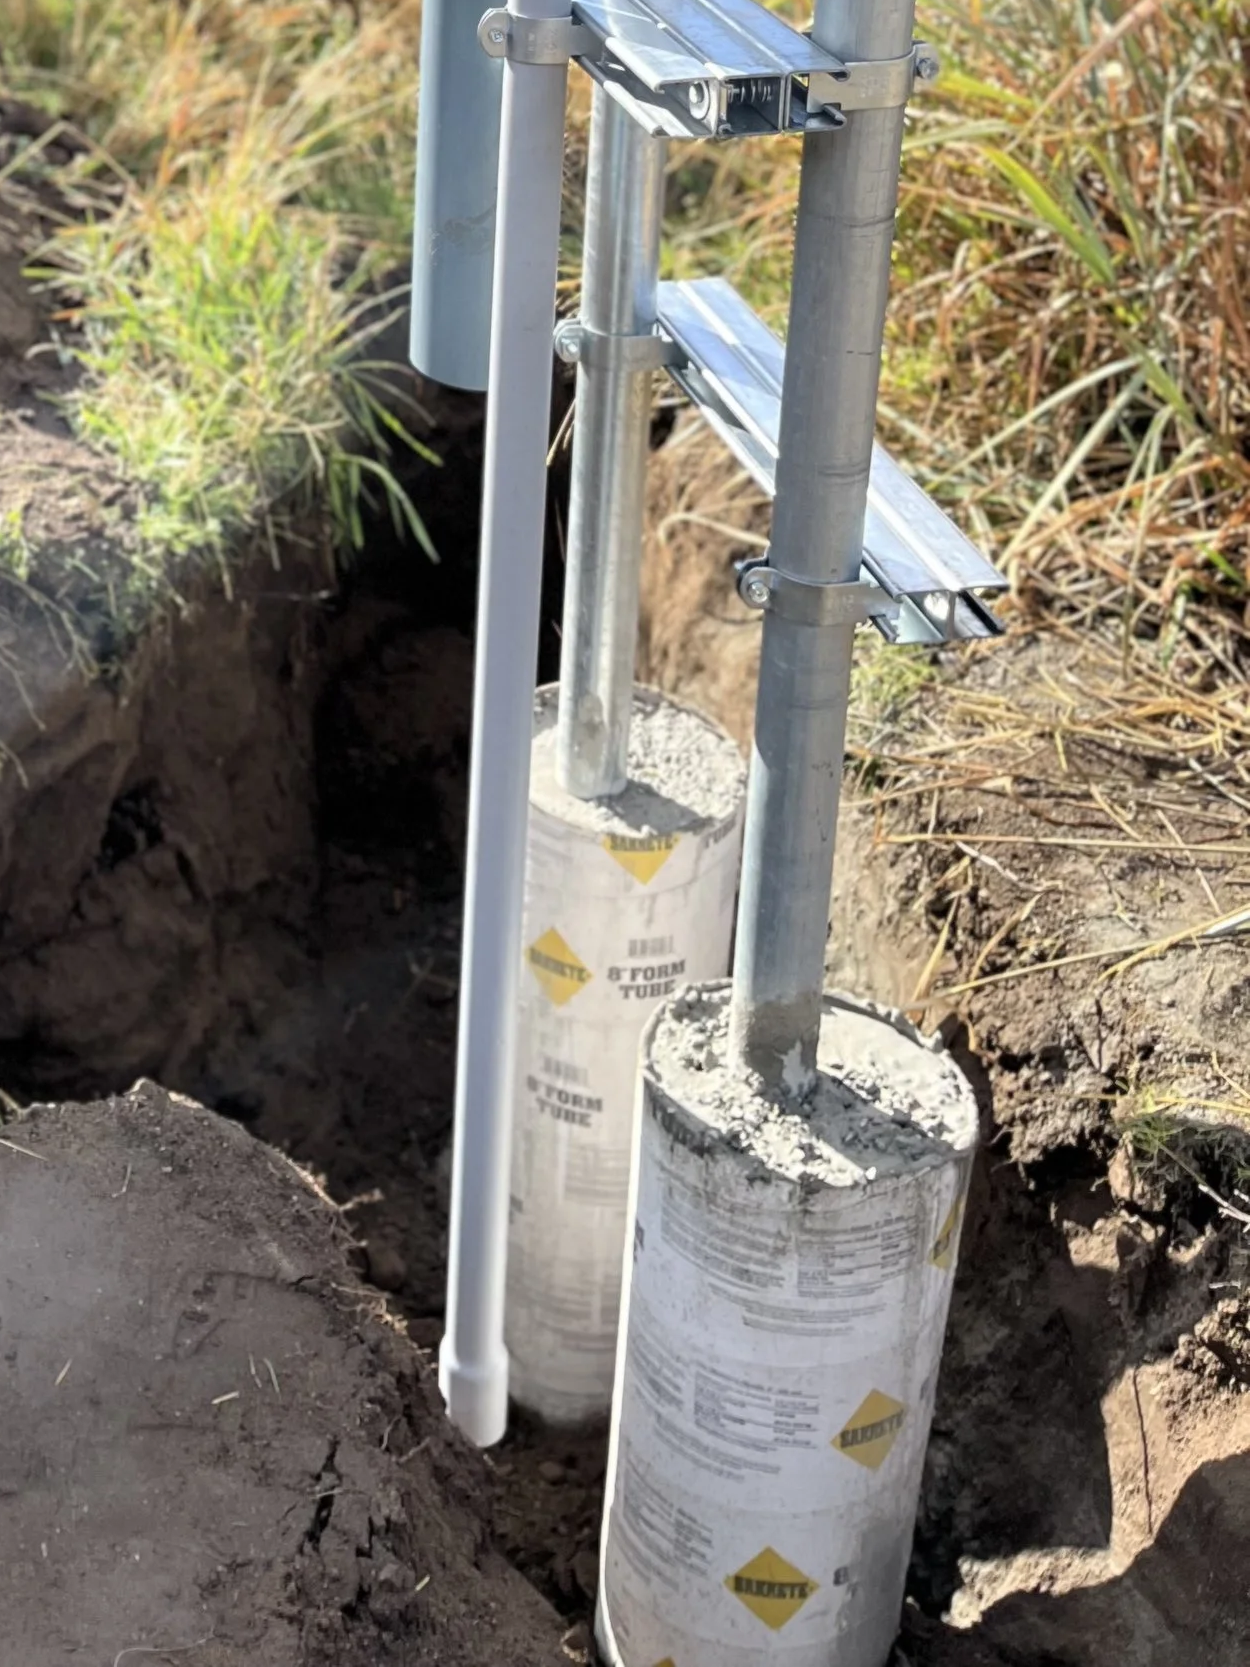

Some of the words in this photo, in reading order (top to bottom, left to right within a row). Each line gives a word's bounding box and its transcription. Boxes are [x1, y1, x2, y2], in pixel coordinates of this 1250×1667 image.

[630, 958, 685, 982] FORM
[619, 979, 676, 1000] TUBE
[544, 1083, 602, 1113] FORM
[535, 1096, 592, 1128] TUBE
